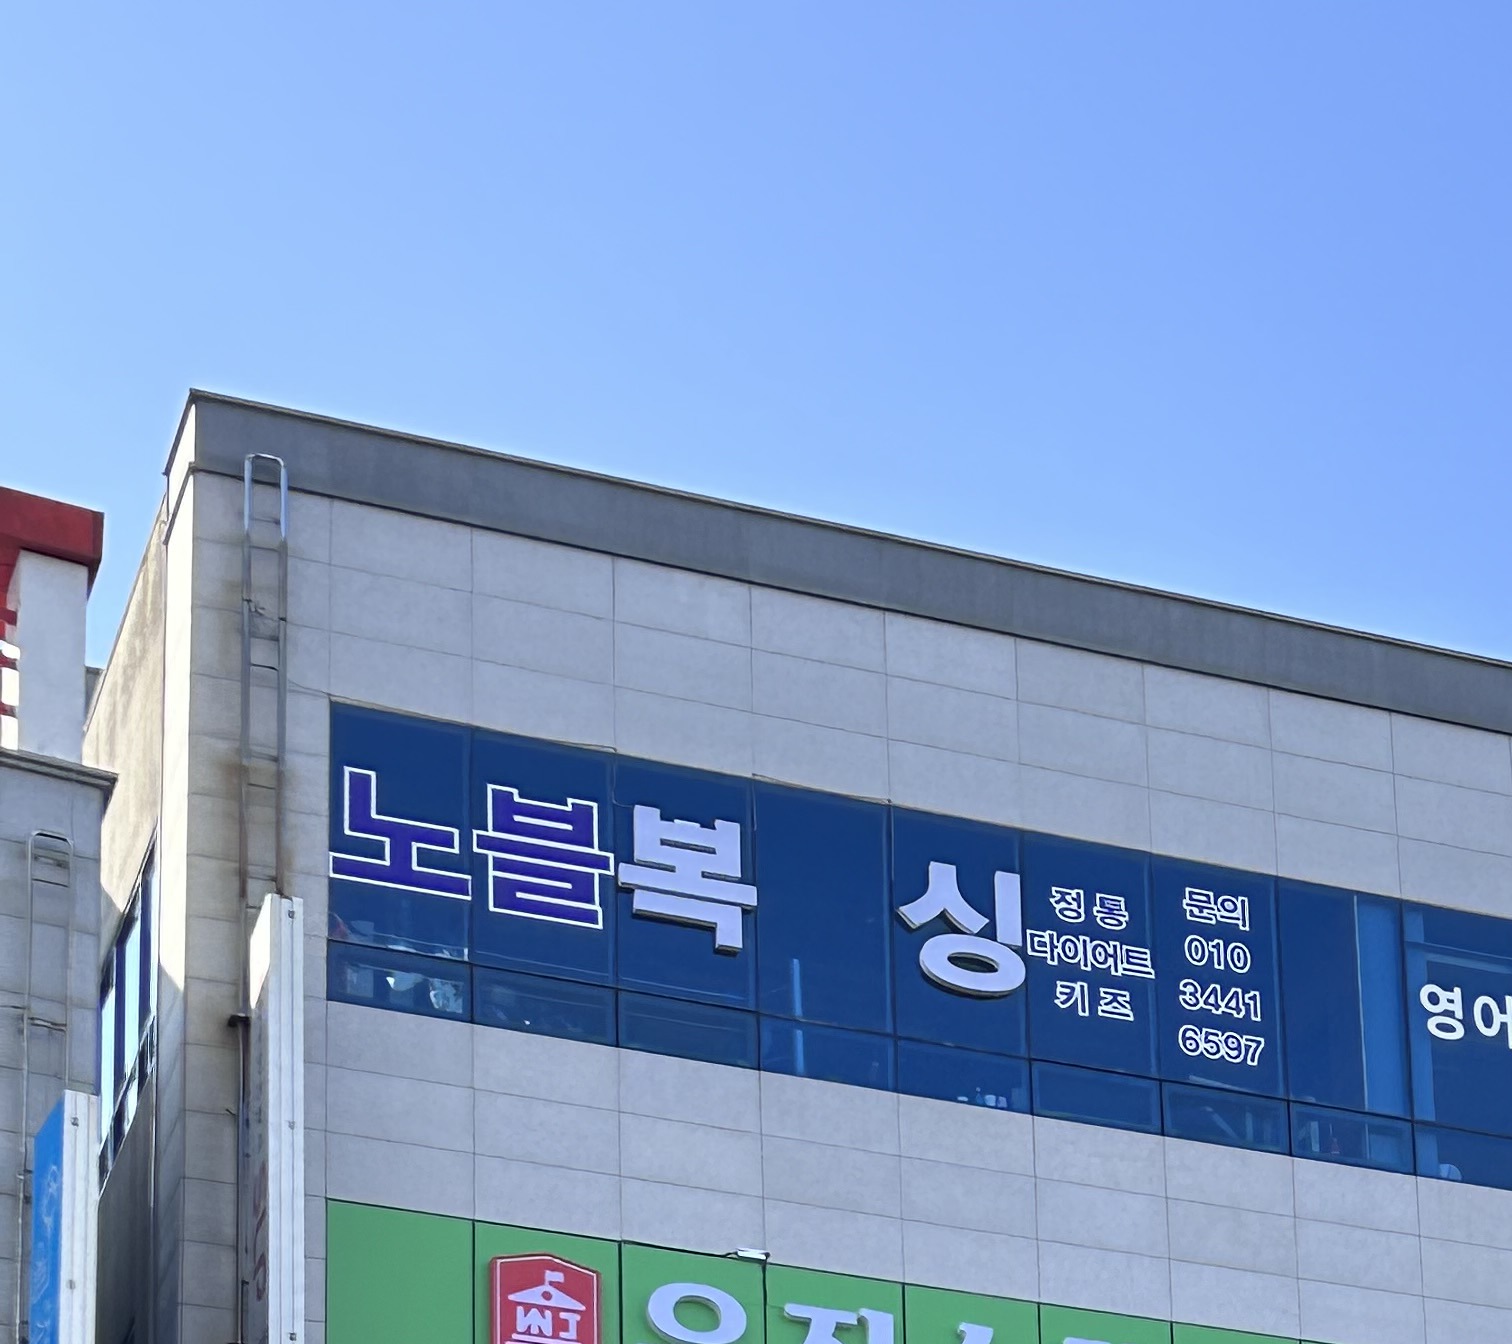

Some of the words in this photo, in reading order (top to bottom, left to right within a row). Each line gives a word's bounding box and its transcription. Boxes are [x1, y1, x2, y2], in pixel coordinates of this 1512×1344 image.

[1182, 887, 1250, 931] 문의
[1026, 930, 1155, 980] 다이어트
[1184, 935, 1252, 974] 010
[1178, 979, 1261, 1022] 3441
[1177, 1024, 1264, 1067] 6597
